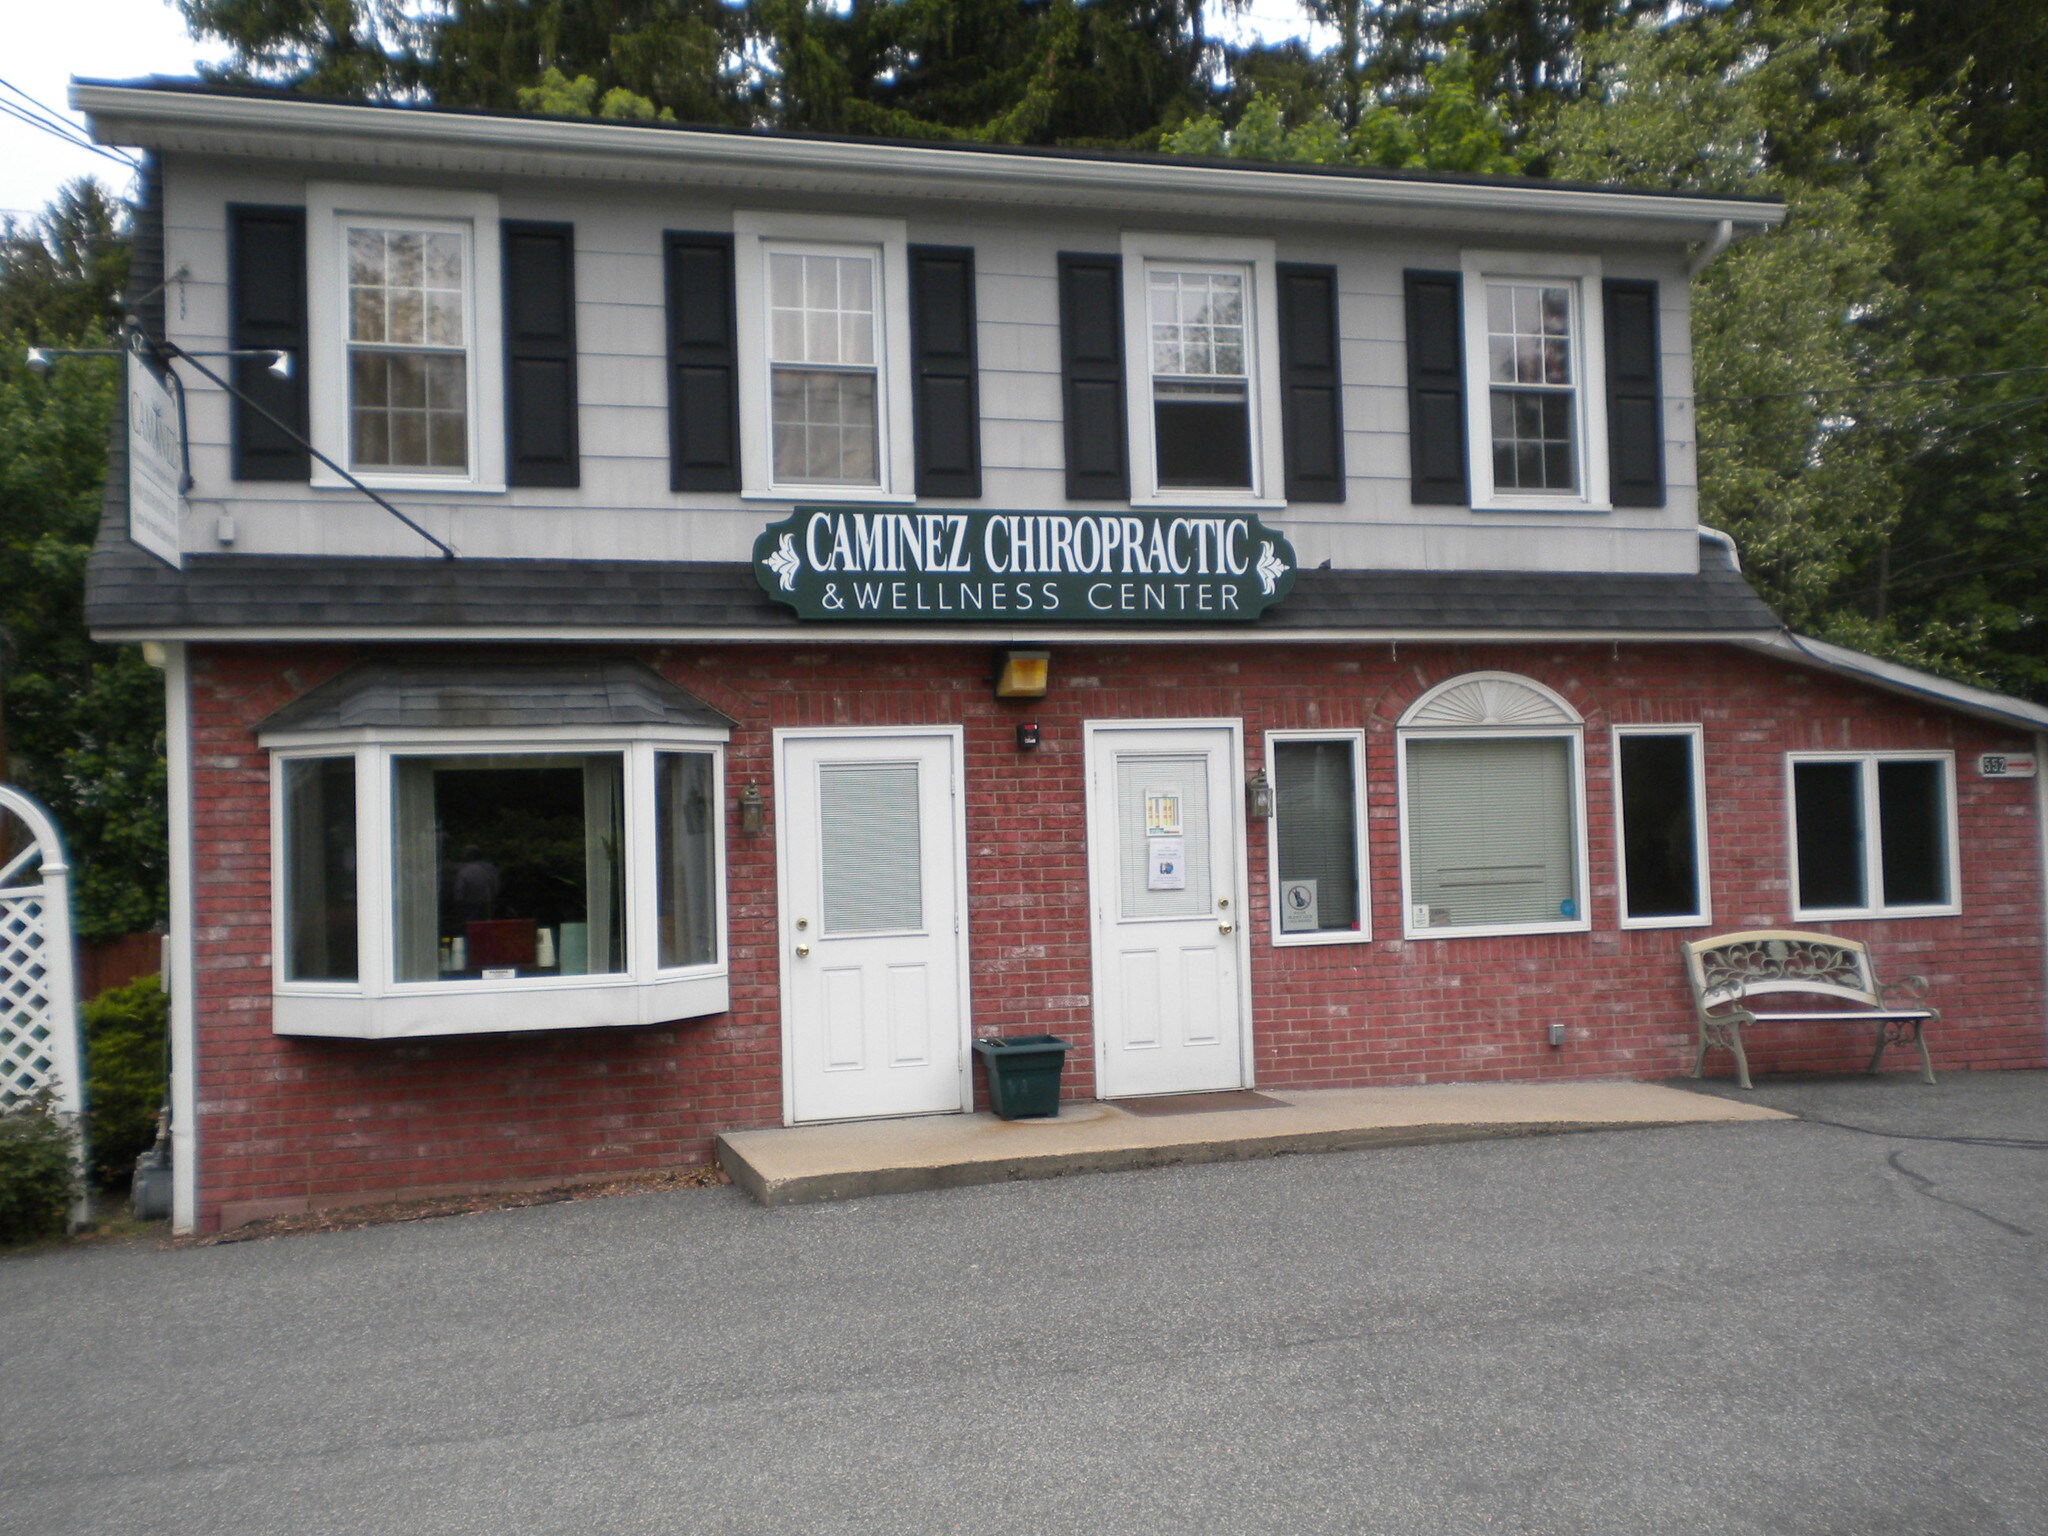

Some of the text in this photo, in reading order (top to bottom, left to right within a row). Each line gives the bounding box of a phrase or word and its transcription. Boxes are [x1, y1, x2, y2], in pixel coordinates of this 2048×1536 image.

[806, 511, 1249, 575] CAMINEZ CHIROPRACTIC
[1087, 582, 1239, 611] CENTER
[1984, 758, 2006, 773] 552
